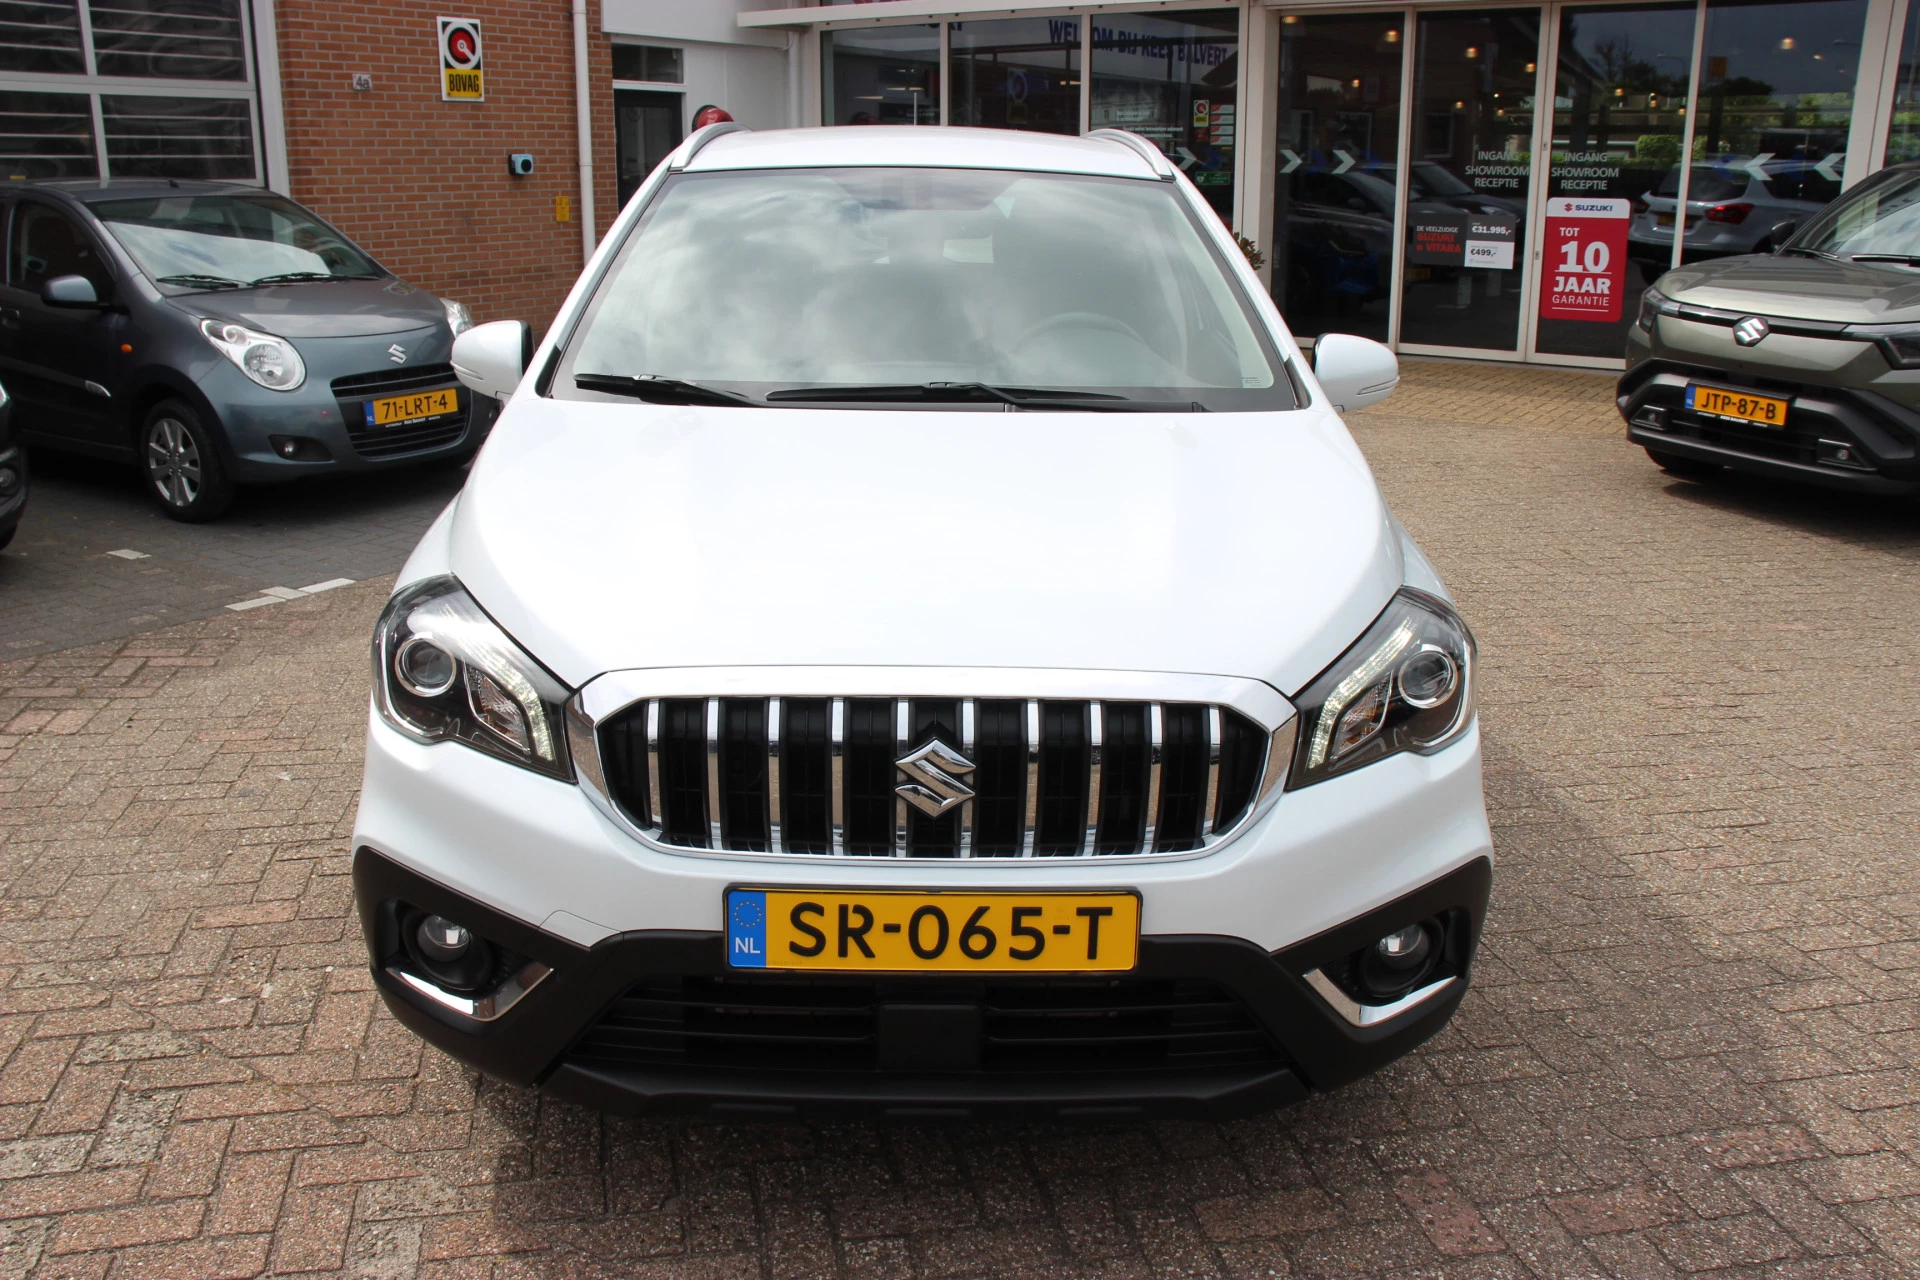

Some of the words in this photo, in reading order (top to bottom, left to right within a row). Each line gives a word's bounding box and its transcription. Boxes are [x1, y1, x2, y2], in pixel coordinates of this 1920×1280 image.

[1049, 19, 1113, 51] WELOM
[1178, 42, 1228, 66] BLVERT
[449, 74, 480, 93] BOVAG
[1477, 151, 1519, 161] INGANG
[1564, 152, 1608, 162] INGANG
[1465, 165, 1530, 176] SHOWROOM
[1551, 167, 1619, 178] SHOWROOM
[1474, 178, 1519, 188] RECEPTIE
[1561, 180, 1608, 190] RECEPTIE
[1575, 204, 1613, 212] SUZUKI
[1559, 227, 1580, 237] TOT
[1558, 240, 1610, 273] 10
[1553, 276, 1612, 294] JAAR
[1552, 294, 1610, 307] GARANTIE
[382, 393, 448, 420] 71-LRT-4
[1701, 392, 1776, 420] JTP-87-B
[735, 937, 761, 954] NL
[788, 901, 1113, 961] SR-065-T
